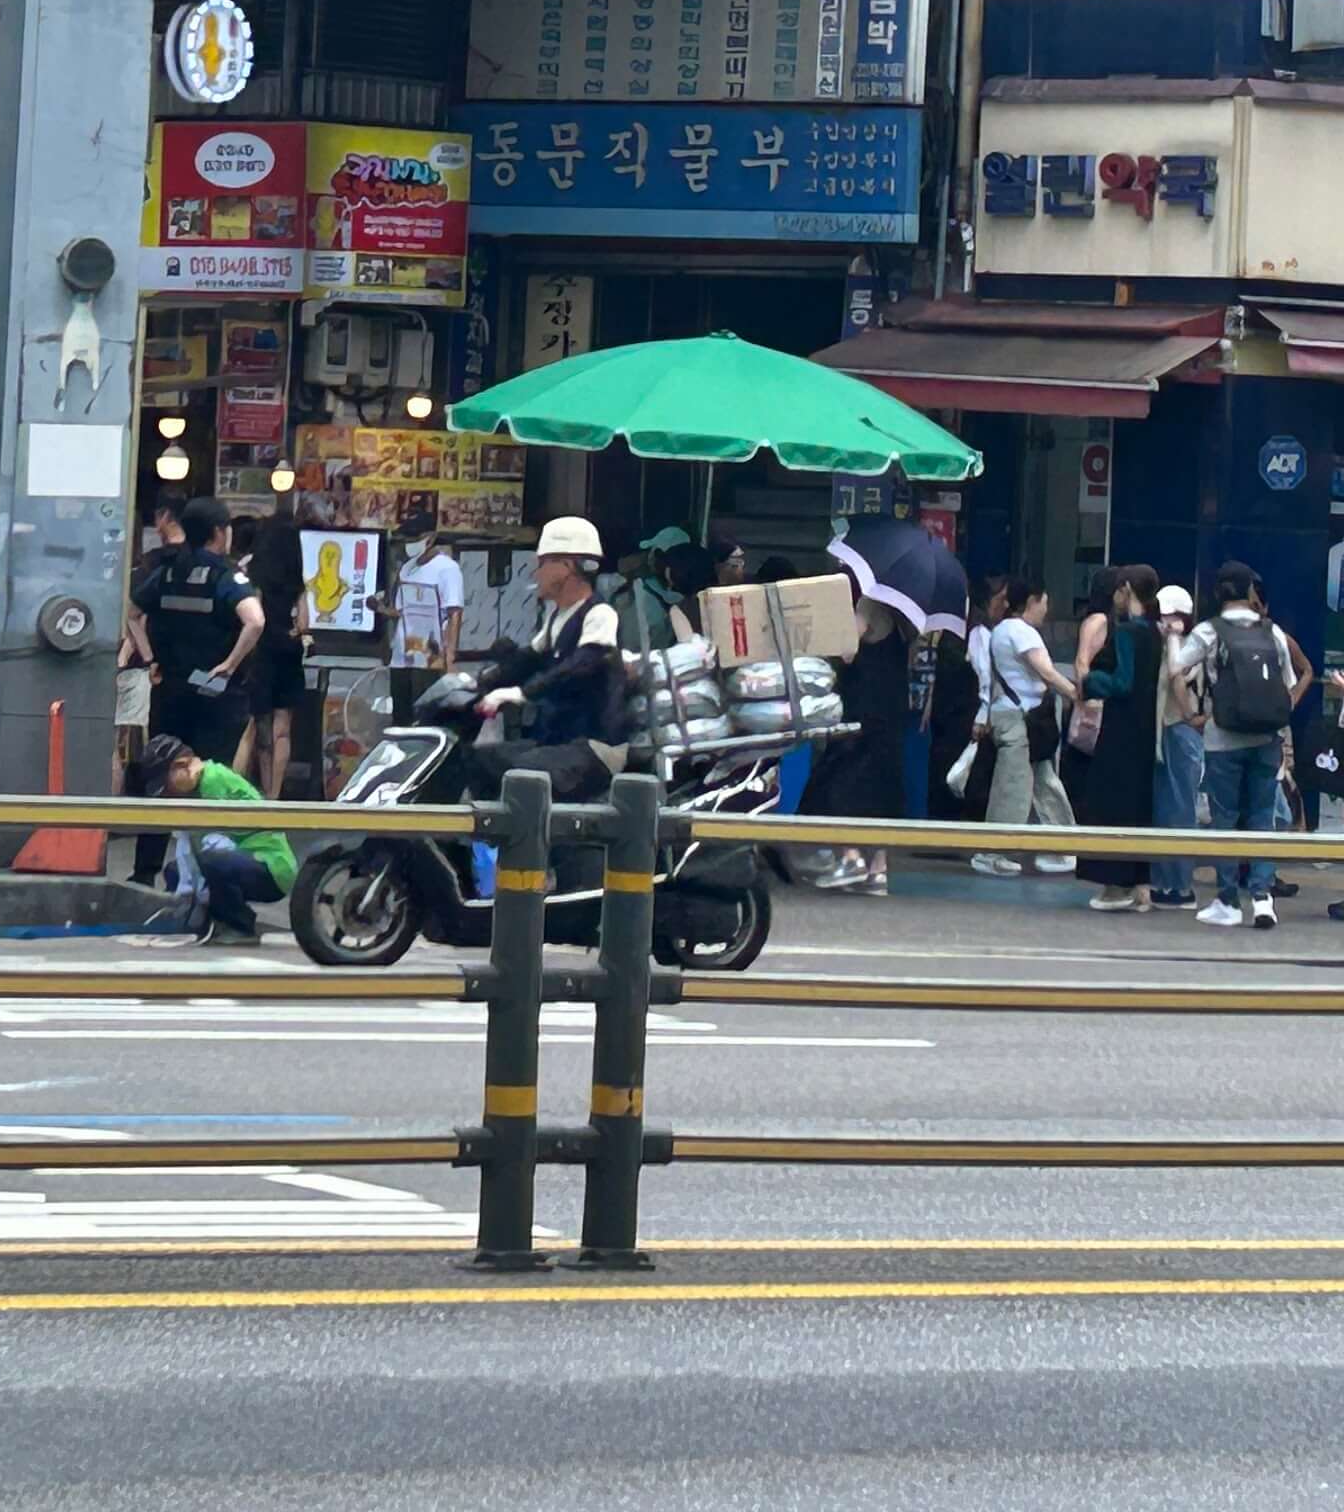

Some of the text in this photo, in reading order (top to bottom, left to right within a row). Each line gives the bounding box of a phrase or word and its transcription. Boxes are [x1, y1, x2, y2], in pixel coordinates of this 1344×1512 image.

[475, 121, 790, 193] 동문직물부
[983, 152, 1220, 224] 열린약국
[1267, 453, 1300, 473] ADT
